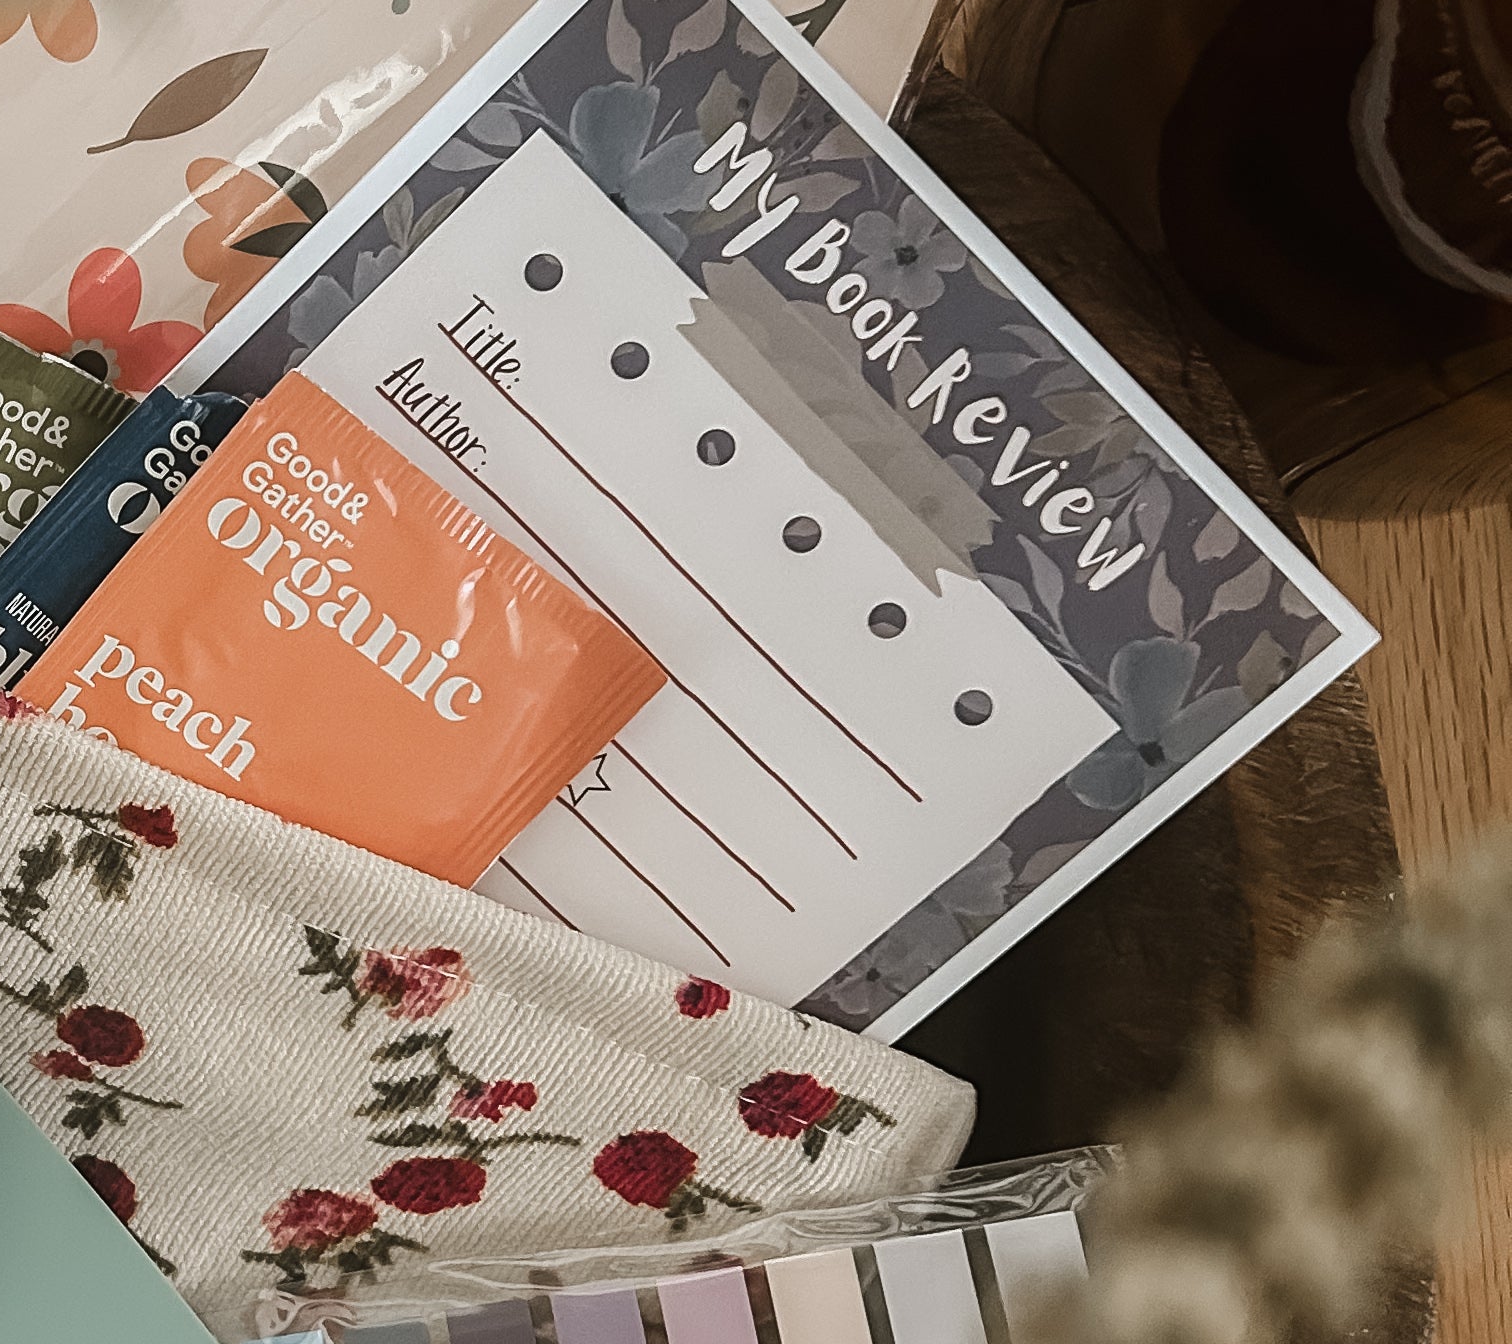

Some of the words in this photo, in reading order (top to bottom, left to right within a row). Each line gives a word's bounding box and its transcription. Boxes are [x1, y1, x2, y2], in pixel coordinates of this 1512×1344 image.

[382, 358, 487, 472] Author:
[448, 294, 522, 390] Title:
[785, 218, 923, 371] Book
[906, 347, 1146, 591] Review
[207, 497, 482, 722] organic
[73, 634, 256, 782] peach
